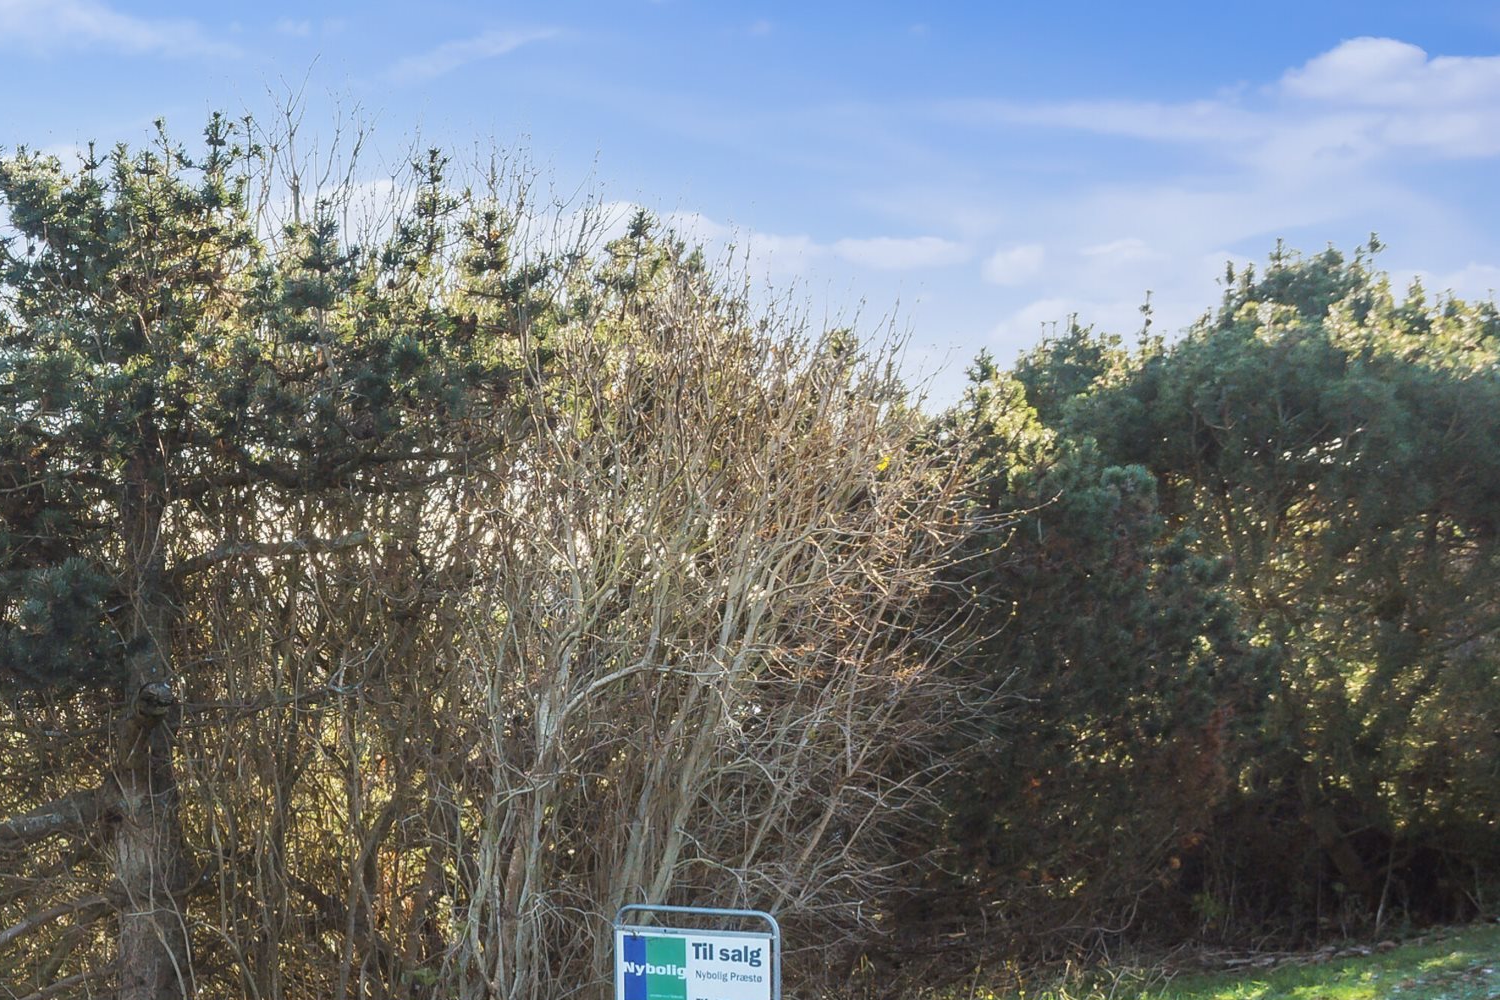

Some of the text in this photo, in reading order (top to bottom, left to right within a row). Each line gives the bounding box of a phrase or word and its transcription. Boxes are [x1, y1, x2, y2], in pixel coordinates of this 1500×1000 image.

[692, 942, 761, 967] Til salg
[624, 962, 686, 979] Nybolig
[696, 970, 762, 983] Nybolig Præstø
